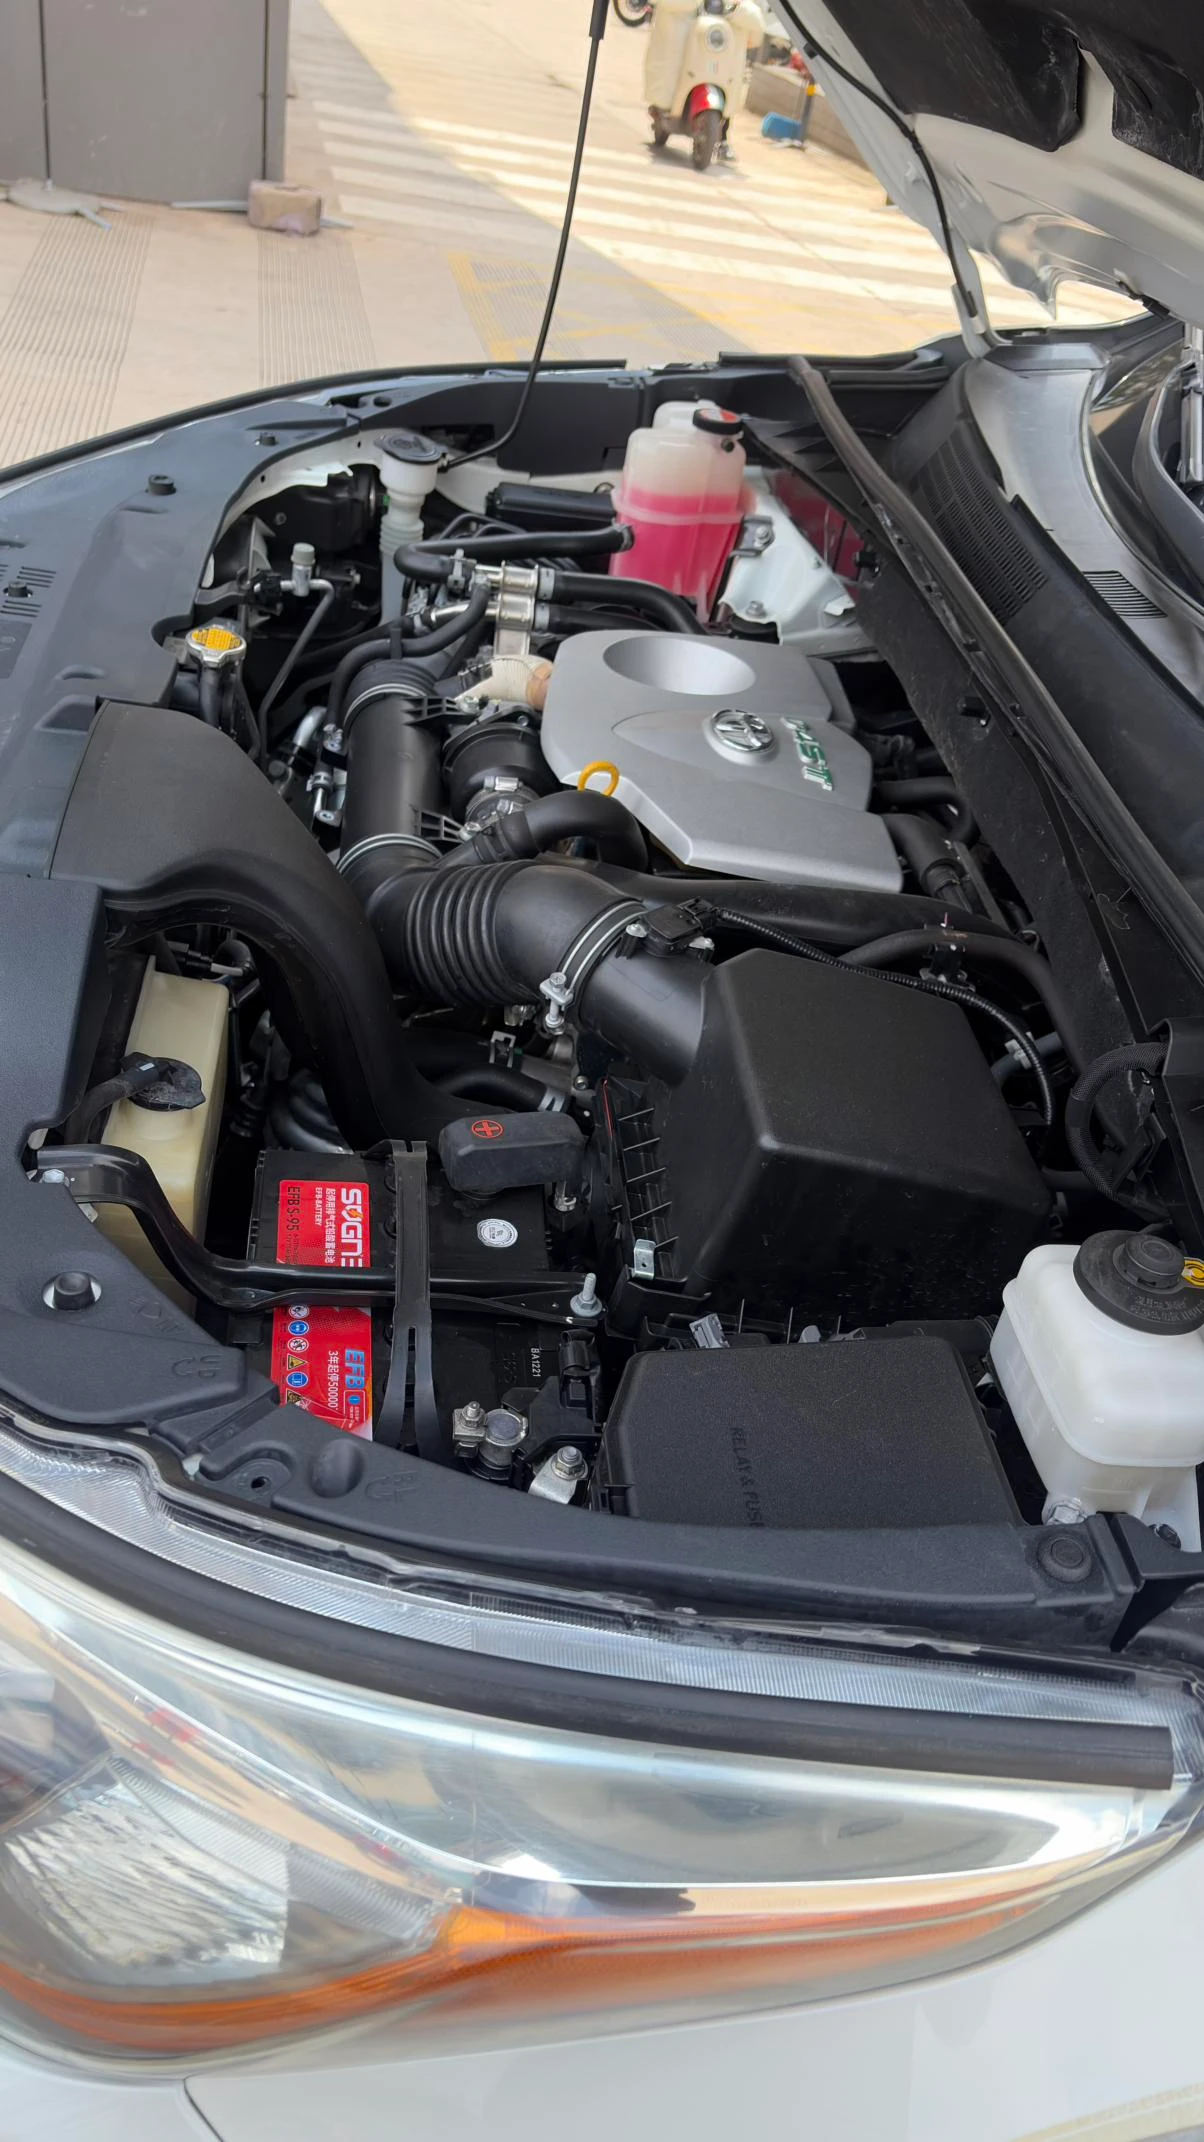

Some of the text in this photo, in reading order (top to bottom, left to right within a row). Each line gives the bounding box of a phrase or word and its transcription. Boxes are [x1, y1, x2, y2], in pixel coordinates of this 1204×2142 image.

[287, 1186, 300, 1206] EFB
[345, 1349, 365, 1389] EFB
[531, 1347, 542, 1377] BA1221
[730, 1427, 752, 1473] RELAY
